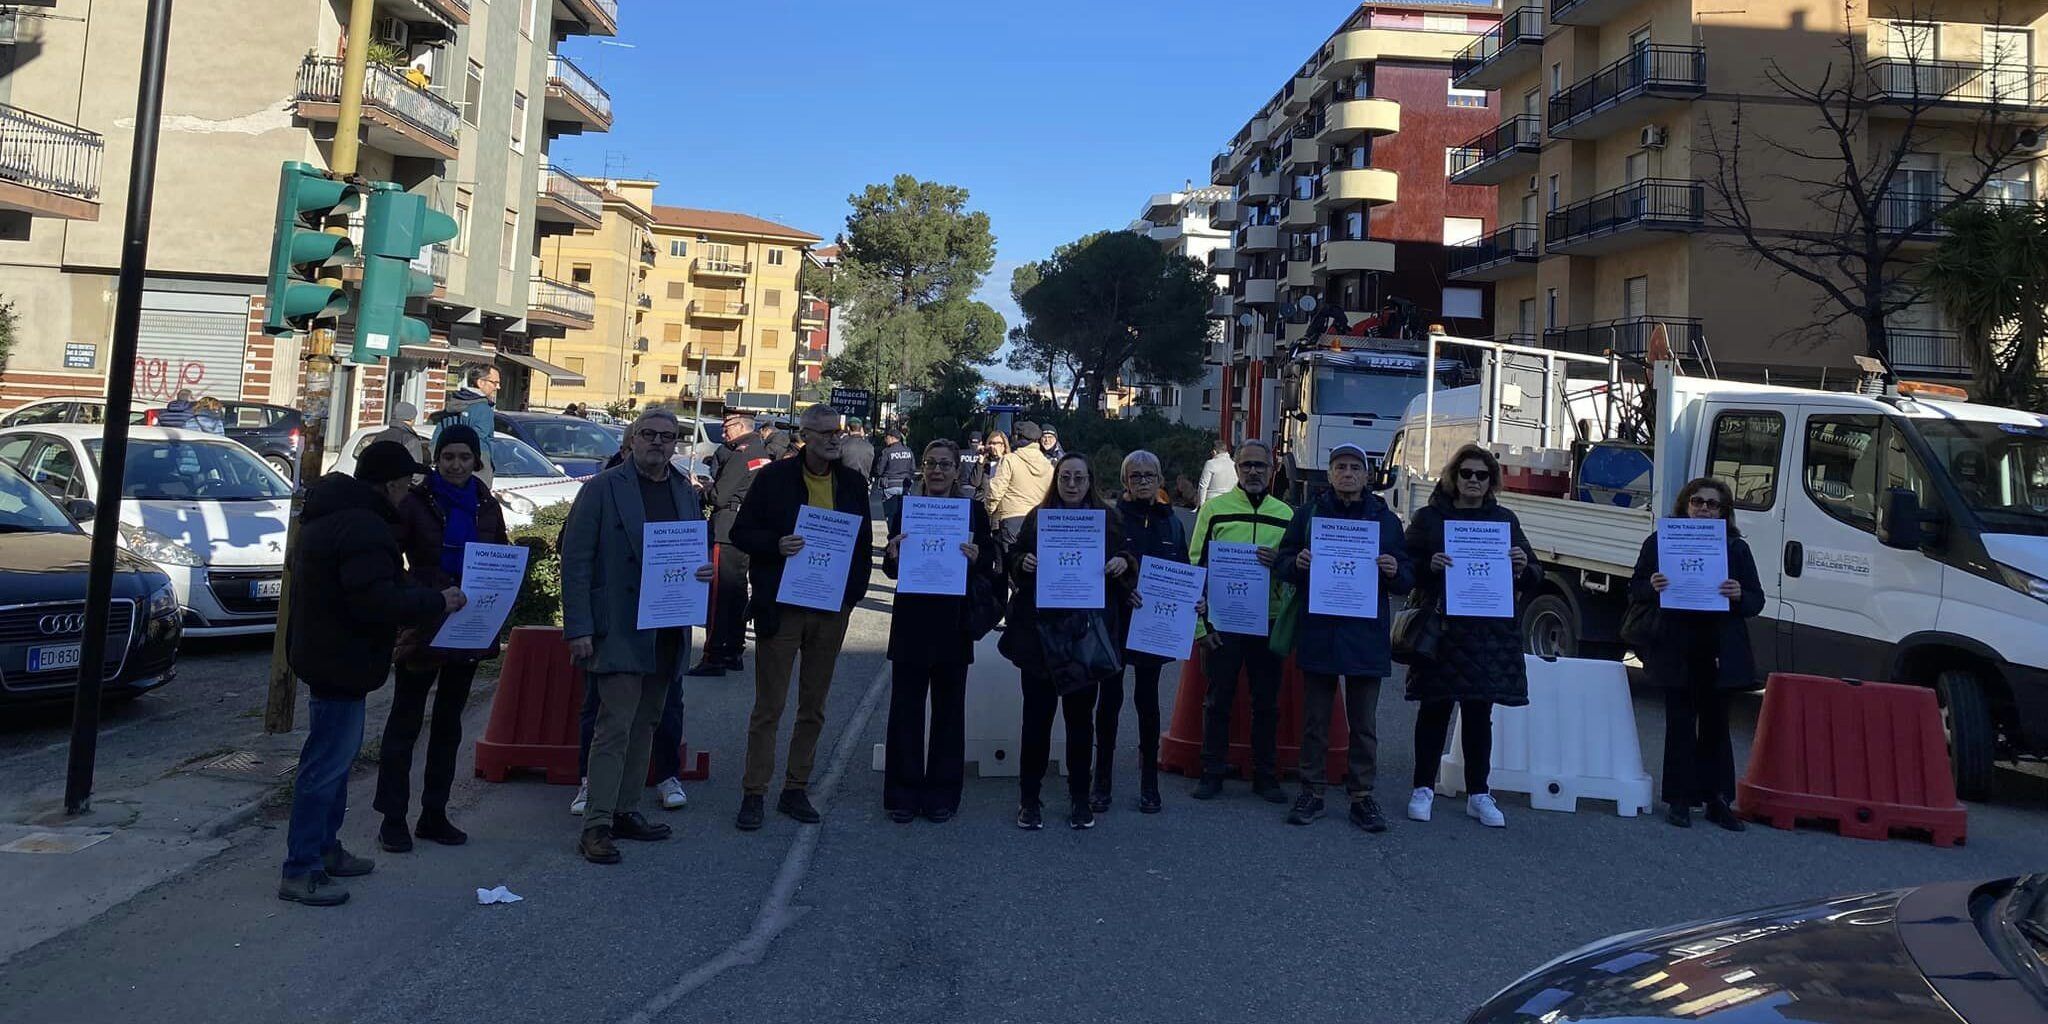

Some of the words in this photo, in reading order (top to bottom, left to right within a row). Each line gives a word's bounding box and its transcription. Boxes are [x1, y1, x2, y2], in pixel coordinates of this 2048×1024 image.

[834, 390, 868, 399] Tabacchi
[832, 397, 867, 406] Morrone
[890, 451, 912, 461] POLIZIA
[808, 512, 821, 520] NON
[475, 550, 489, 558] NON
[1150, 563, 1164, 571] NON
